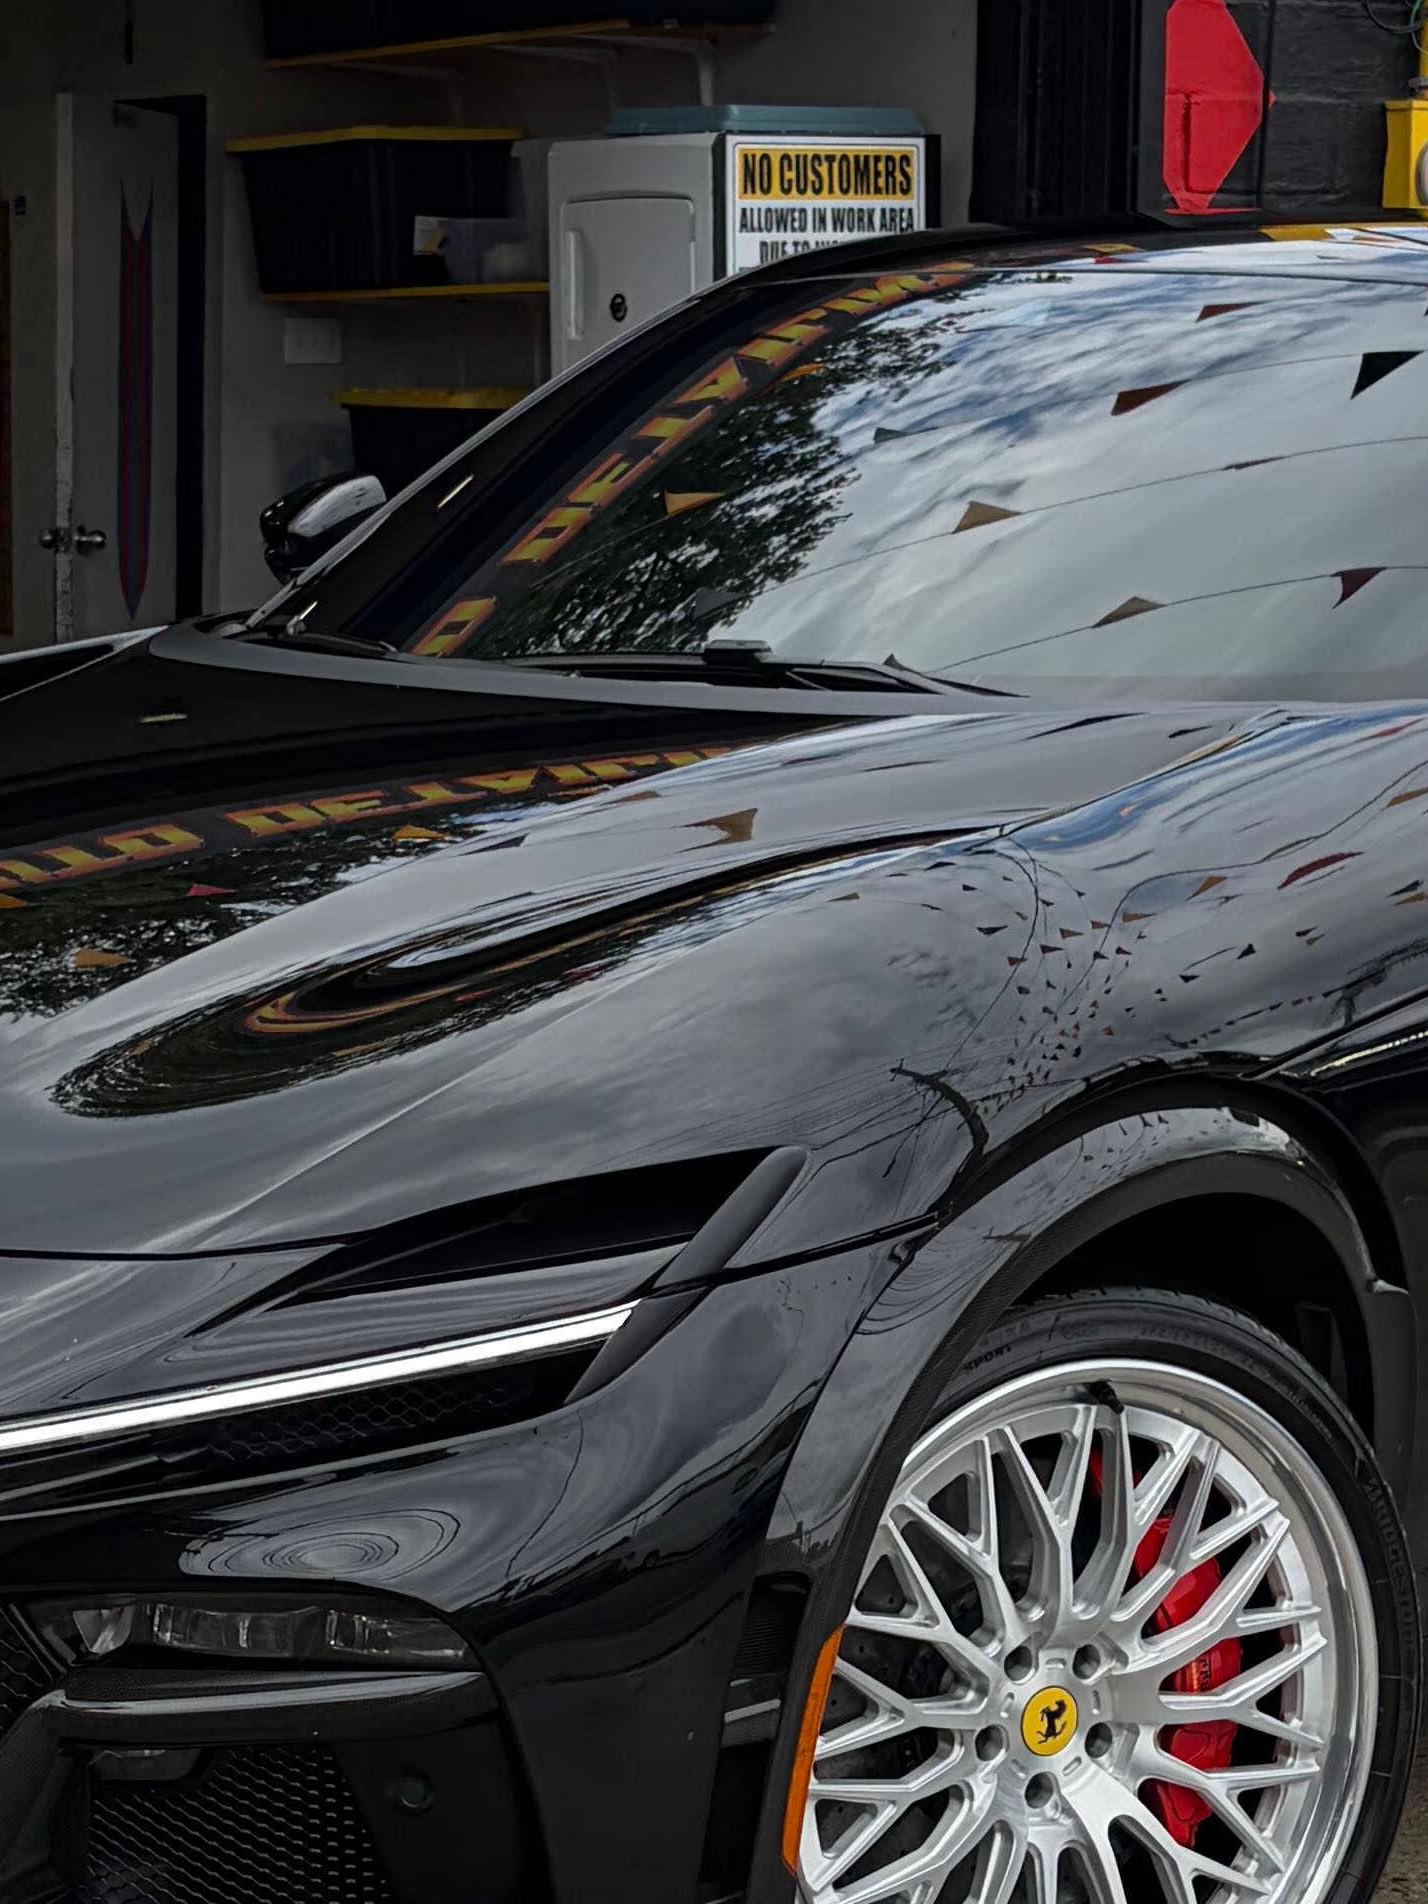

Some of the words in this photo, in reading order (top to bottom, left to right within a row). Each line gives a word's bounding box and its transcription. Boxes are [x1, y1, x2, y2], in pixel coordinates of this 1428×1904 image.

[743, 153, 771, 195] NO
[779, 153, 911, 195] CUSTOMERS
[739, 207, 807, 233] ALLOWED
[812, 207, 827, 233] IN
[831, 207, 876, 233] WORK
[880, 207, 914, 233] AREA
